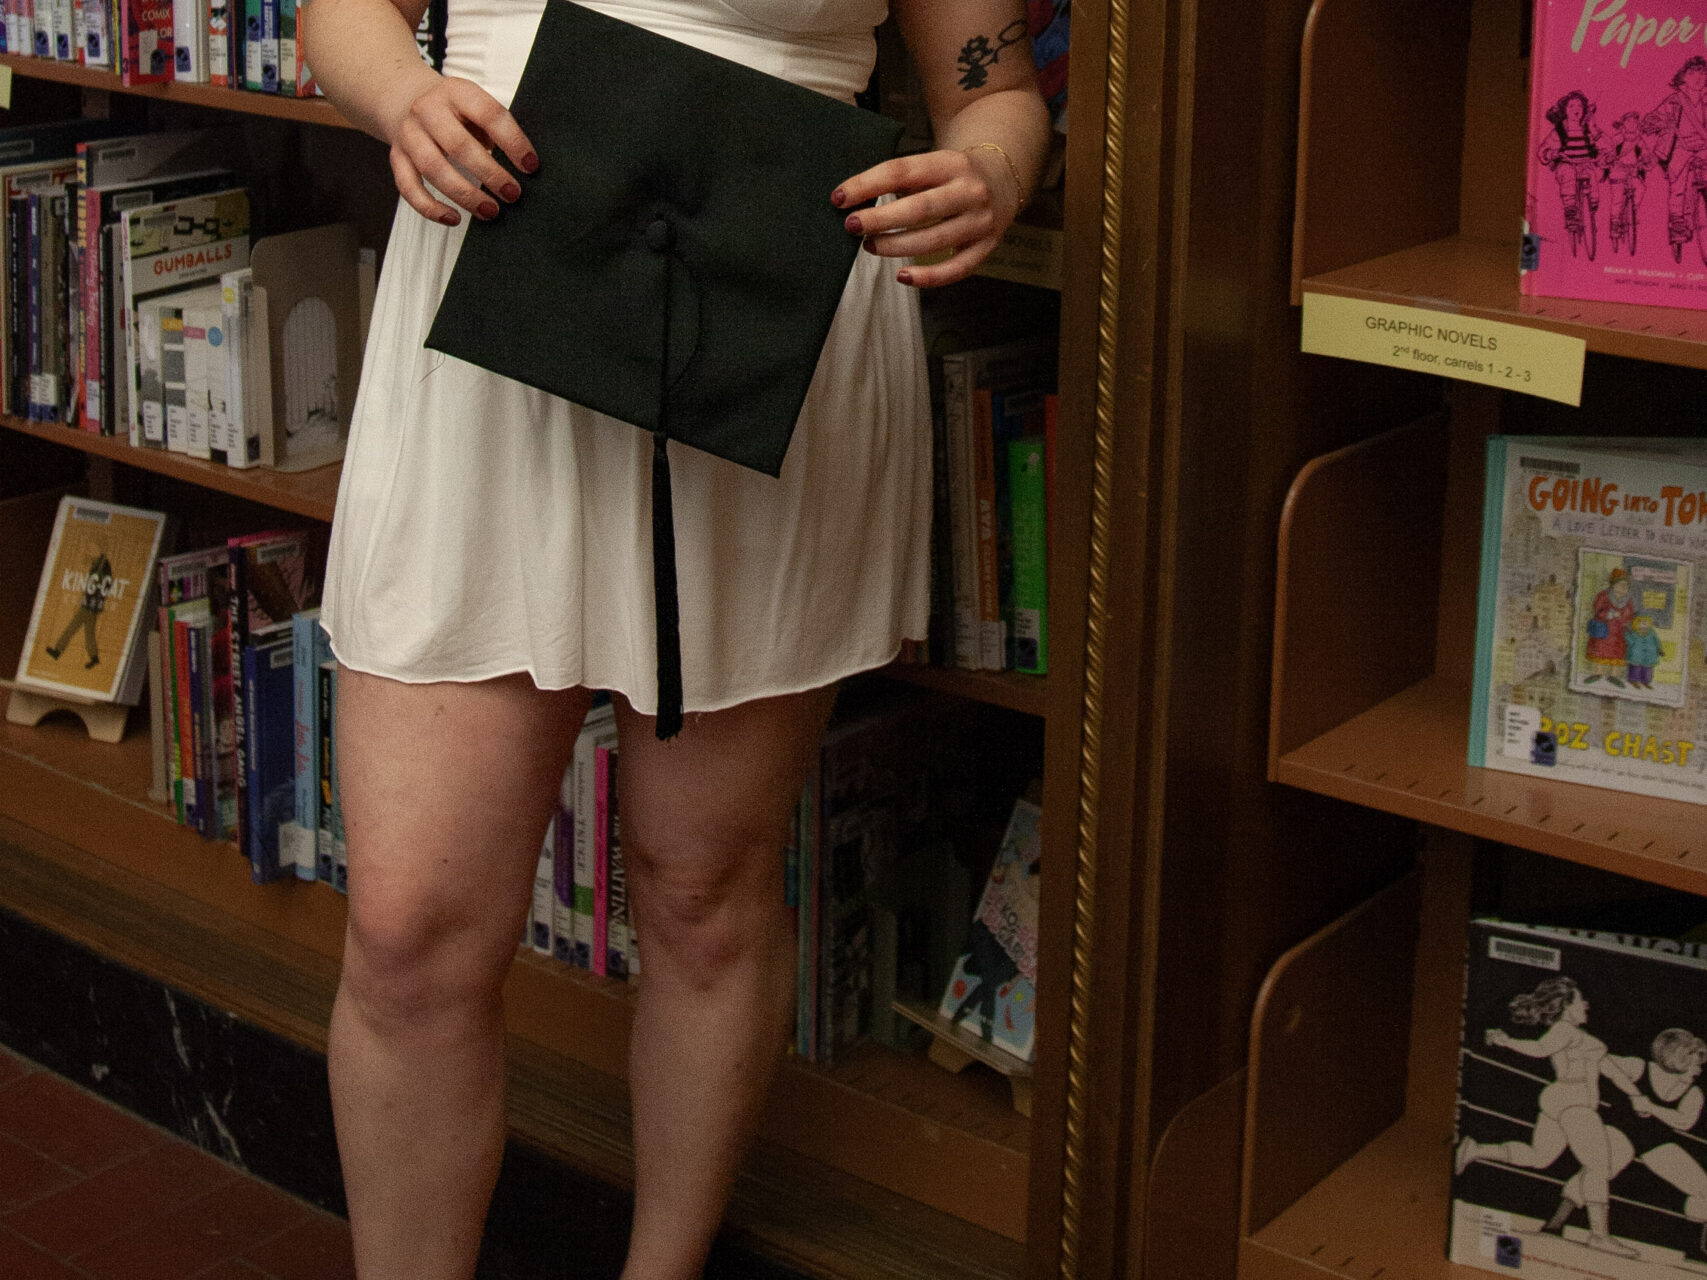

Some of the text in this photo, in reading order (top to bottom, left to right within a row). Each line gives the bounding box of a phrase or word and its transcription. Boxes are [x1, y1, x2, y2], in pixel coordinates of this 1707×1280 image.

[153, 243, 233, 276] GUMBALLS
[1365, 316, 1498, 352] GRAPHIC NOVELS
[1392, 344, 1532, 383] 2nd floor, carrels 1 2 3
[981, 499, 991, 541] AYA
[1528, 475, 1707, 527] GOING INTO TO
[1567, 521, 1594, 534] LOVE
[1601, 523, 1639, 539] LETTER
[230, 596, 246, 788] THE STREET ANGEL GANG
[1604, 731, 1695, 767] CHAST
[610, 845, 626, 920] WAITIN
